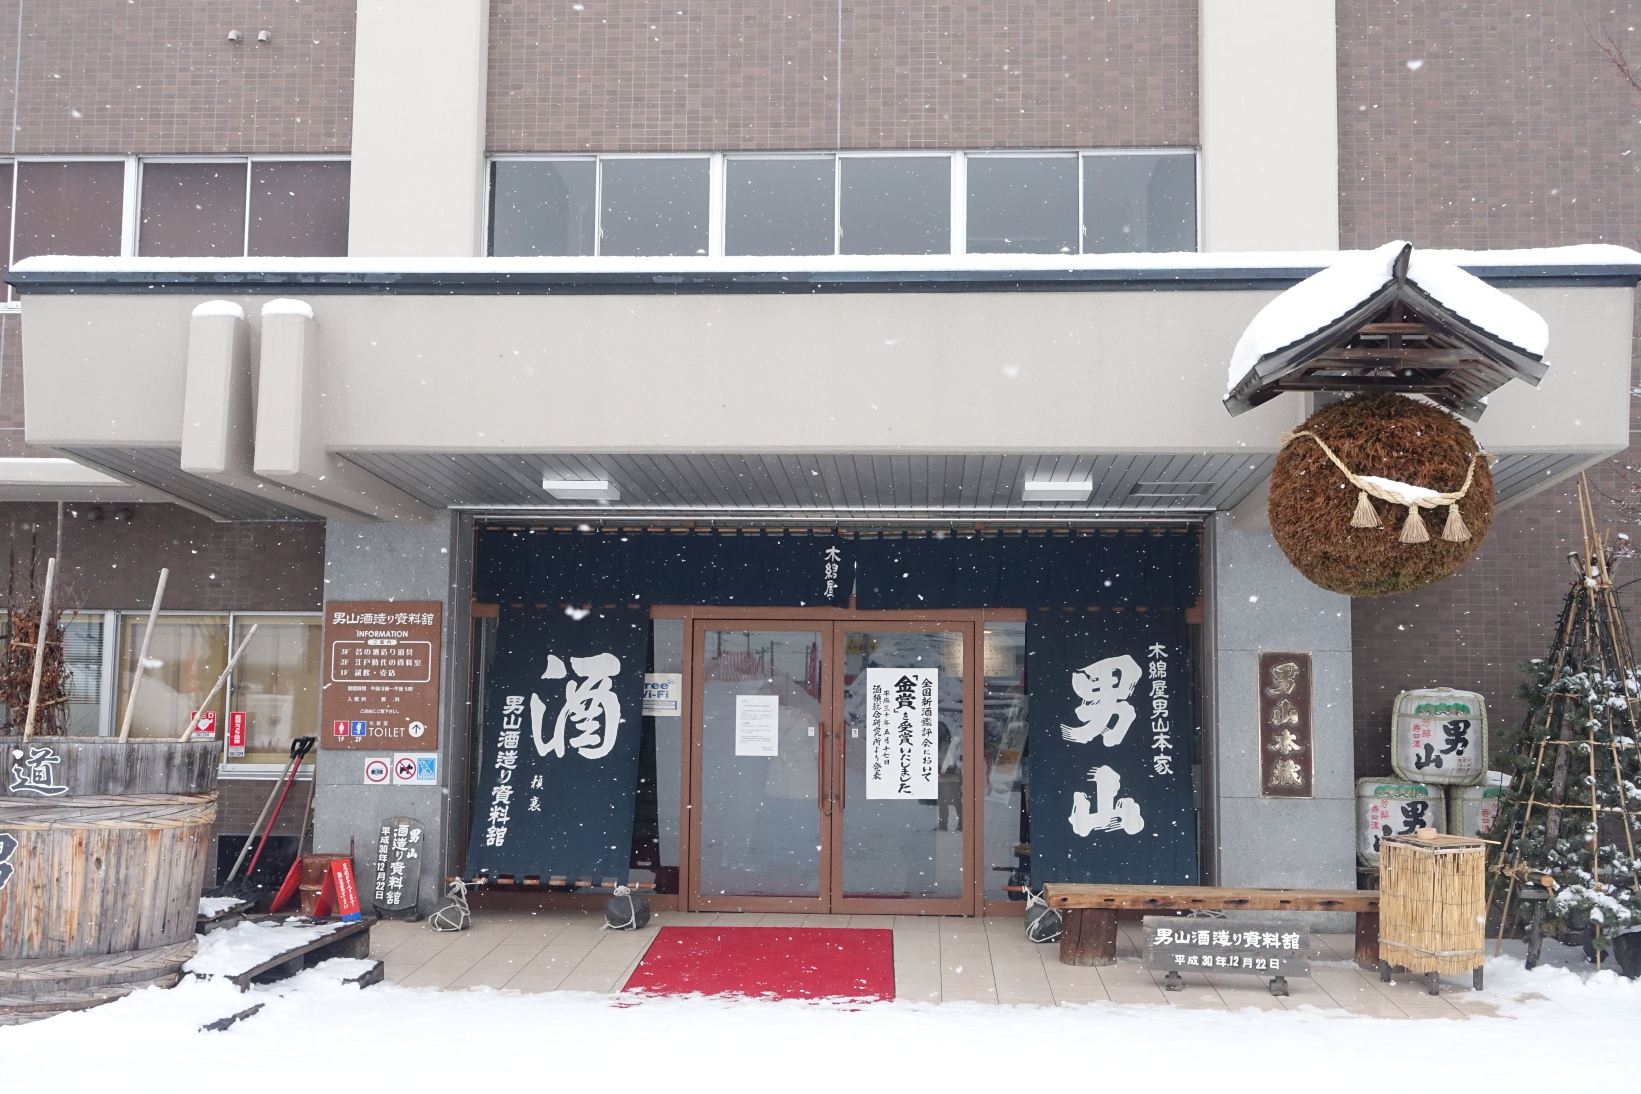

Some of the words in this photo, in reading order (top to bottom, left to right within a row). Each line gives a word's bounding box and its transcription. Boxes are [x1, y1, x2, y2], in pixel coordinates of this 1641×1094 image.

[823, 545, 842, 600] 木綿屋
[340, 648, 349, 656] 3F
[356, 630, 409, 638] INFORMATION
[368, 727, 406, 737] TOILET
[530, 652, 621, 760] 酒
[920, 677, 933, 782] 全国新酒鑑評会において
[1147, 642, 1174, 776] 木綿屋男山本家
[1059, 654, 1145, 838] 男山
[1414, 719, 1472, 771] 男山
[9, 747, 69, 796] 道
[375, 826, 391, 900] 平成30年12月22日
[406, 827, 422, 859] 男山
[1174, 954, 1281, 970] 平成30年12月22日
